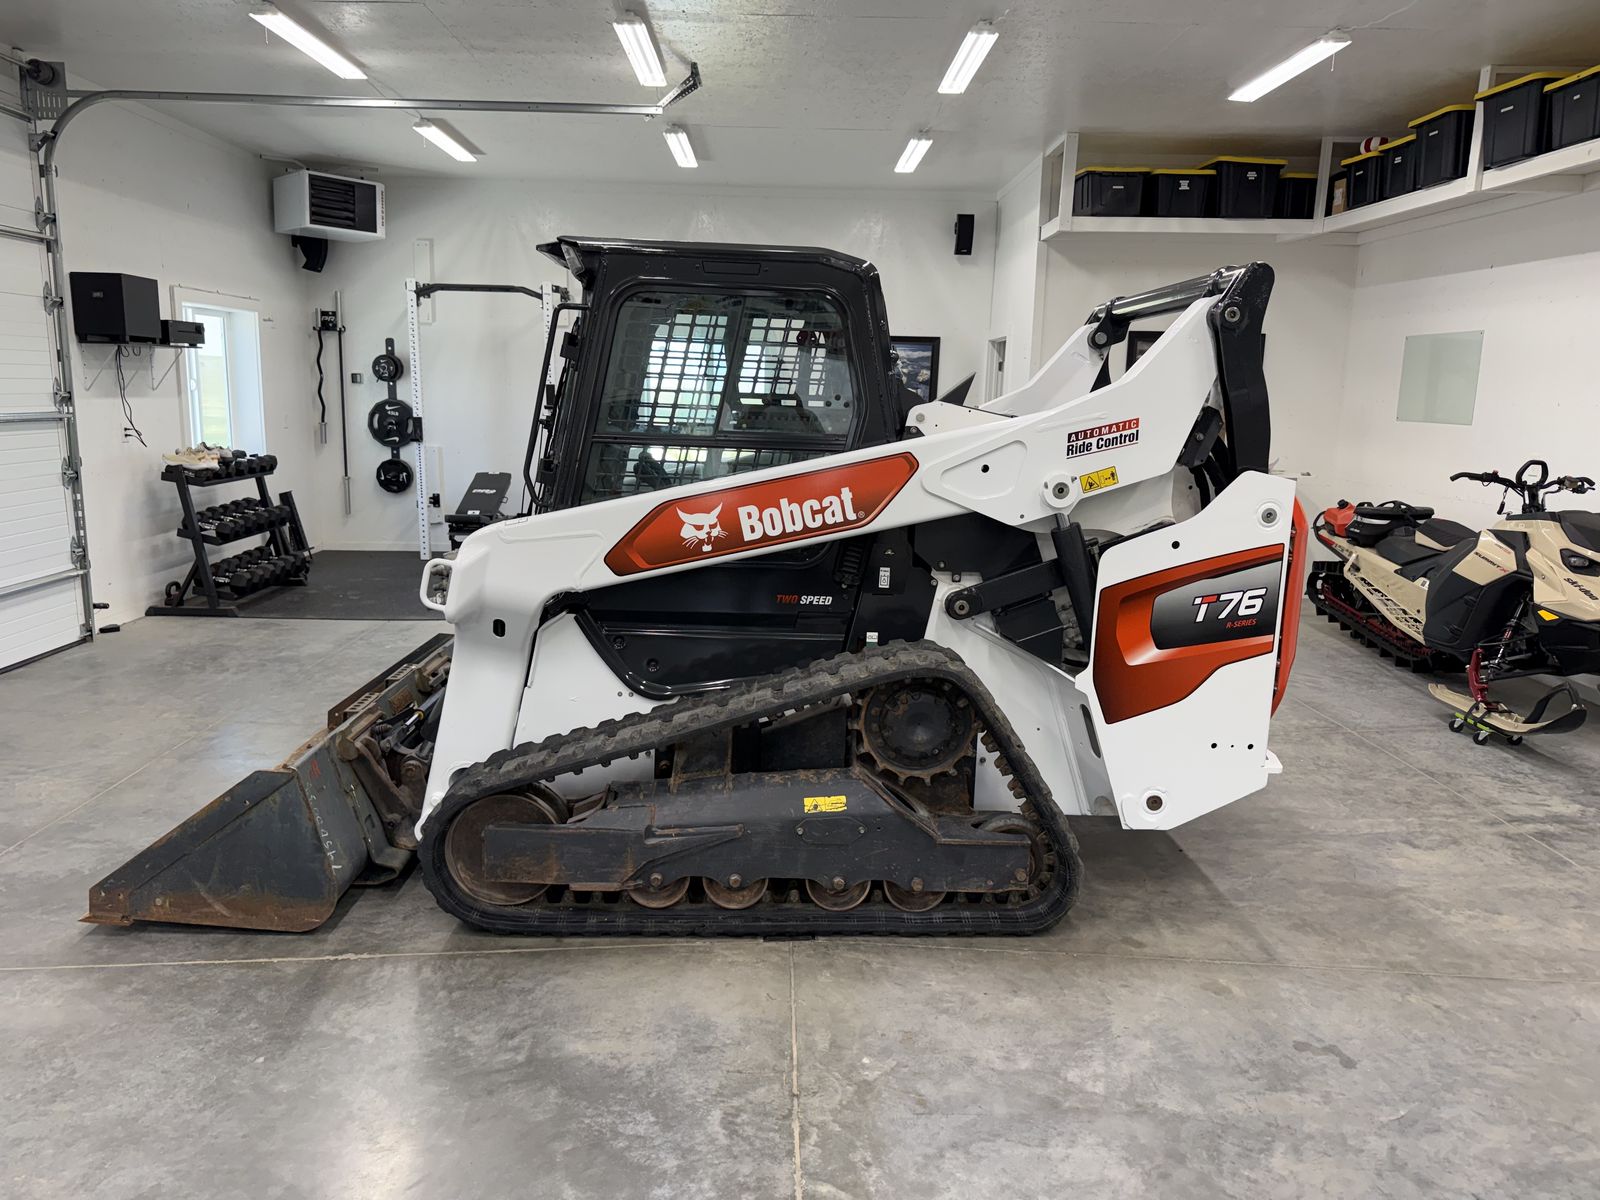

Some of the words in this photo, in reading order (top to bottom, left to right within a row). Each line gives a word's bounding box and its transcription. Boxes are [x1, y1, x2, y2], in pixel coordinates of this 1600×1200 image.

[1066, 441, 1092, 456] Ride
[1096, 430, 1139, 449] Control
[1070, 420, 1137, 442] AUTOMATIC
[737, 486, 857, 542] Bobcat
[776, 594, 799, 604] TWO
[799, 595, 832, 605] SPEED
[1193, 587, 1267, 623] T76
[1226, 618, 1257, 629] R-SERIES
